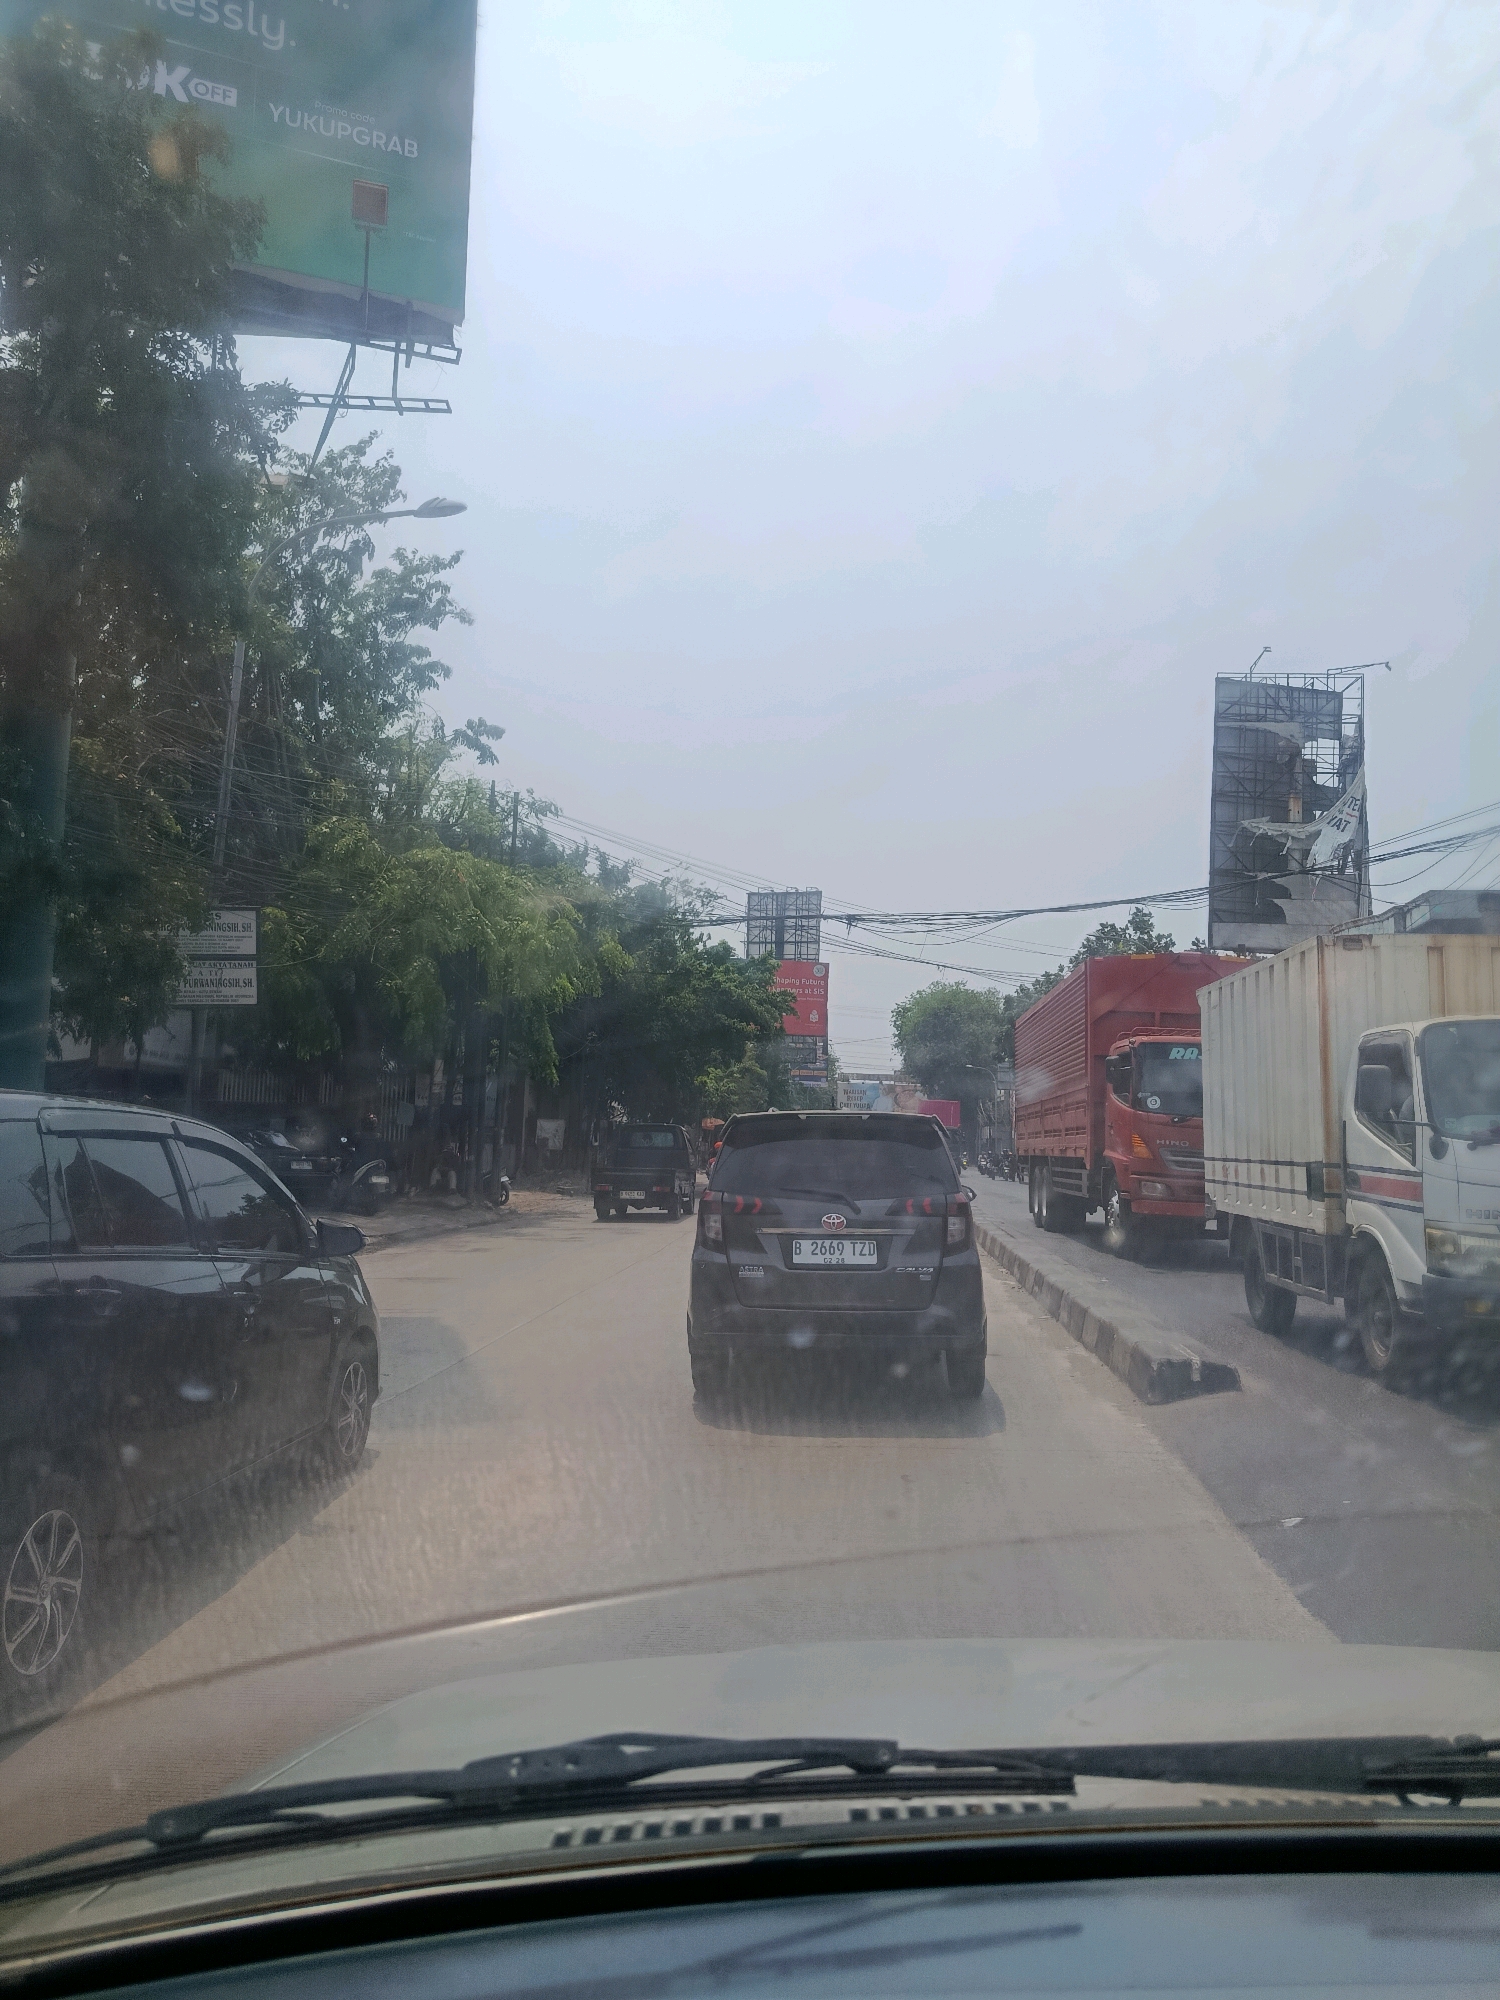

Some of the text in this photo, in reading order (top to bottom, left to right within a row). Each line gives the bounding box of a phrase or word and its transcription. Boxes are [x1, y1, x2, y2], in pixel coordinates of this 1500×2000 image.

[194, 81, 234, 103] OFF
[315, 100, 377, 125] Promo code
[269, 102, 419, 159] YUKUPGRAB
[801, 978, 825, 986] Future
[1169, 1047, 1203, 1060] RA
[1156, 1139, 1190, 1147] HINO
[794, 1240, 876, 1256] B 2669 TZD
